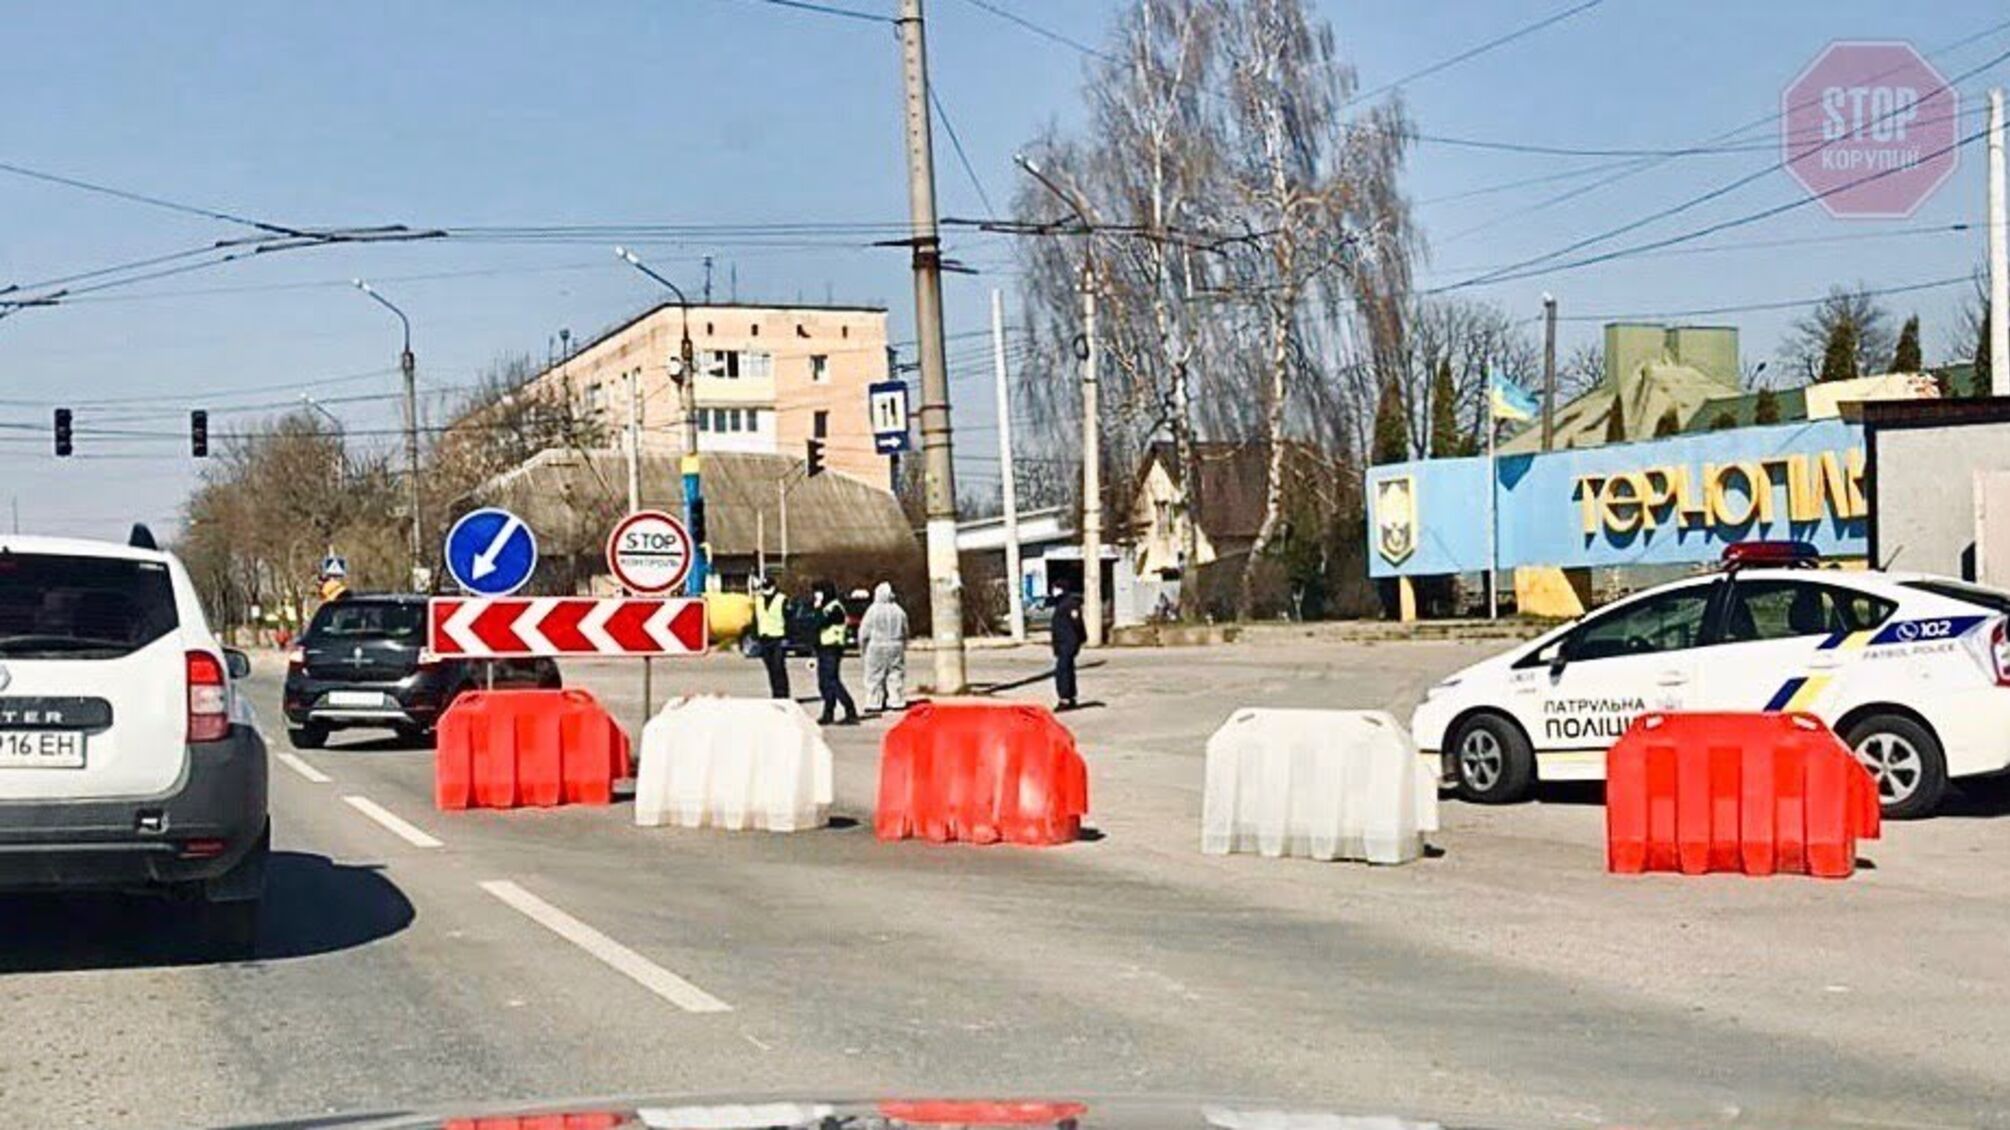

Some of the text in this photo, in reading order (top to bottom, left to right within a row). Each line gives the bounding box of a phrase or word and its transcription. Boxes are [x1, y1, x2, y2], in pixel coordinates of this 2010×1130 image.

[626, 532, 677, 549] STOP
[1920, 620, 1951, 637] 102
[1544, 698, 1646, 714] ПАТРУЛЬНА
[1546, 716, 1633, 738] ПОЛІЦІ
[0, 734, 74, 755] 16 EH
